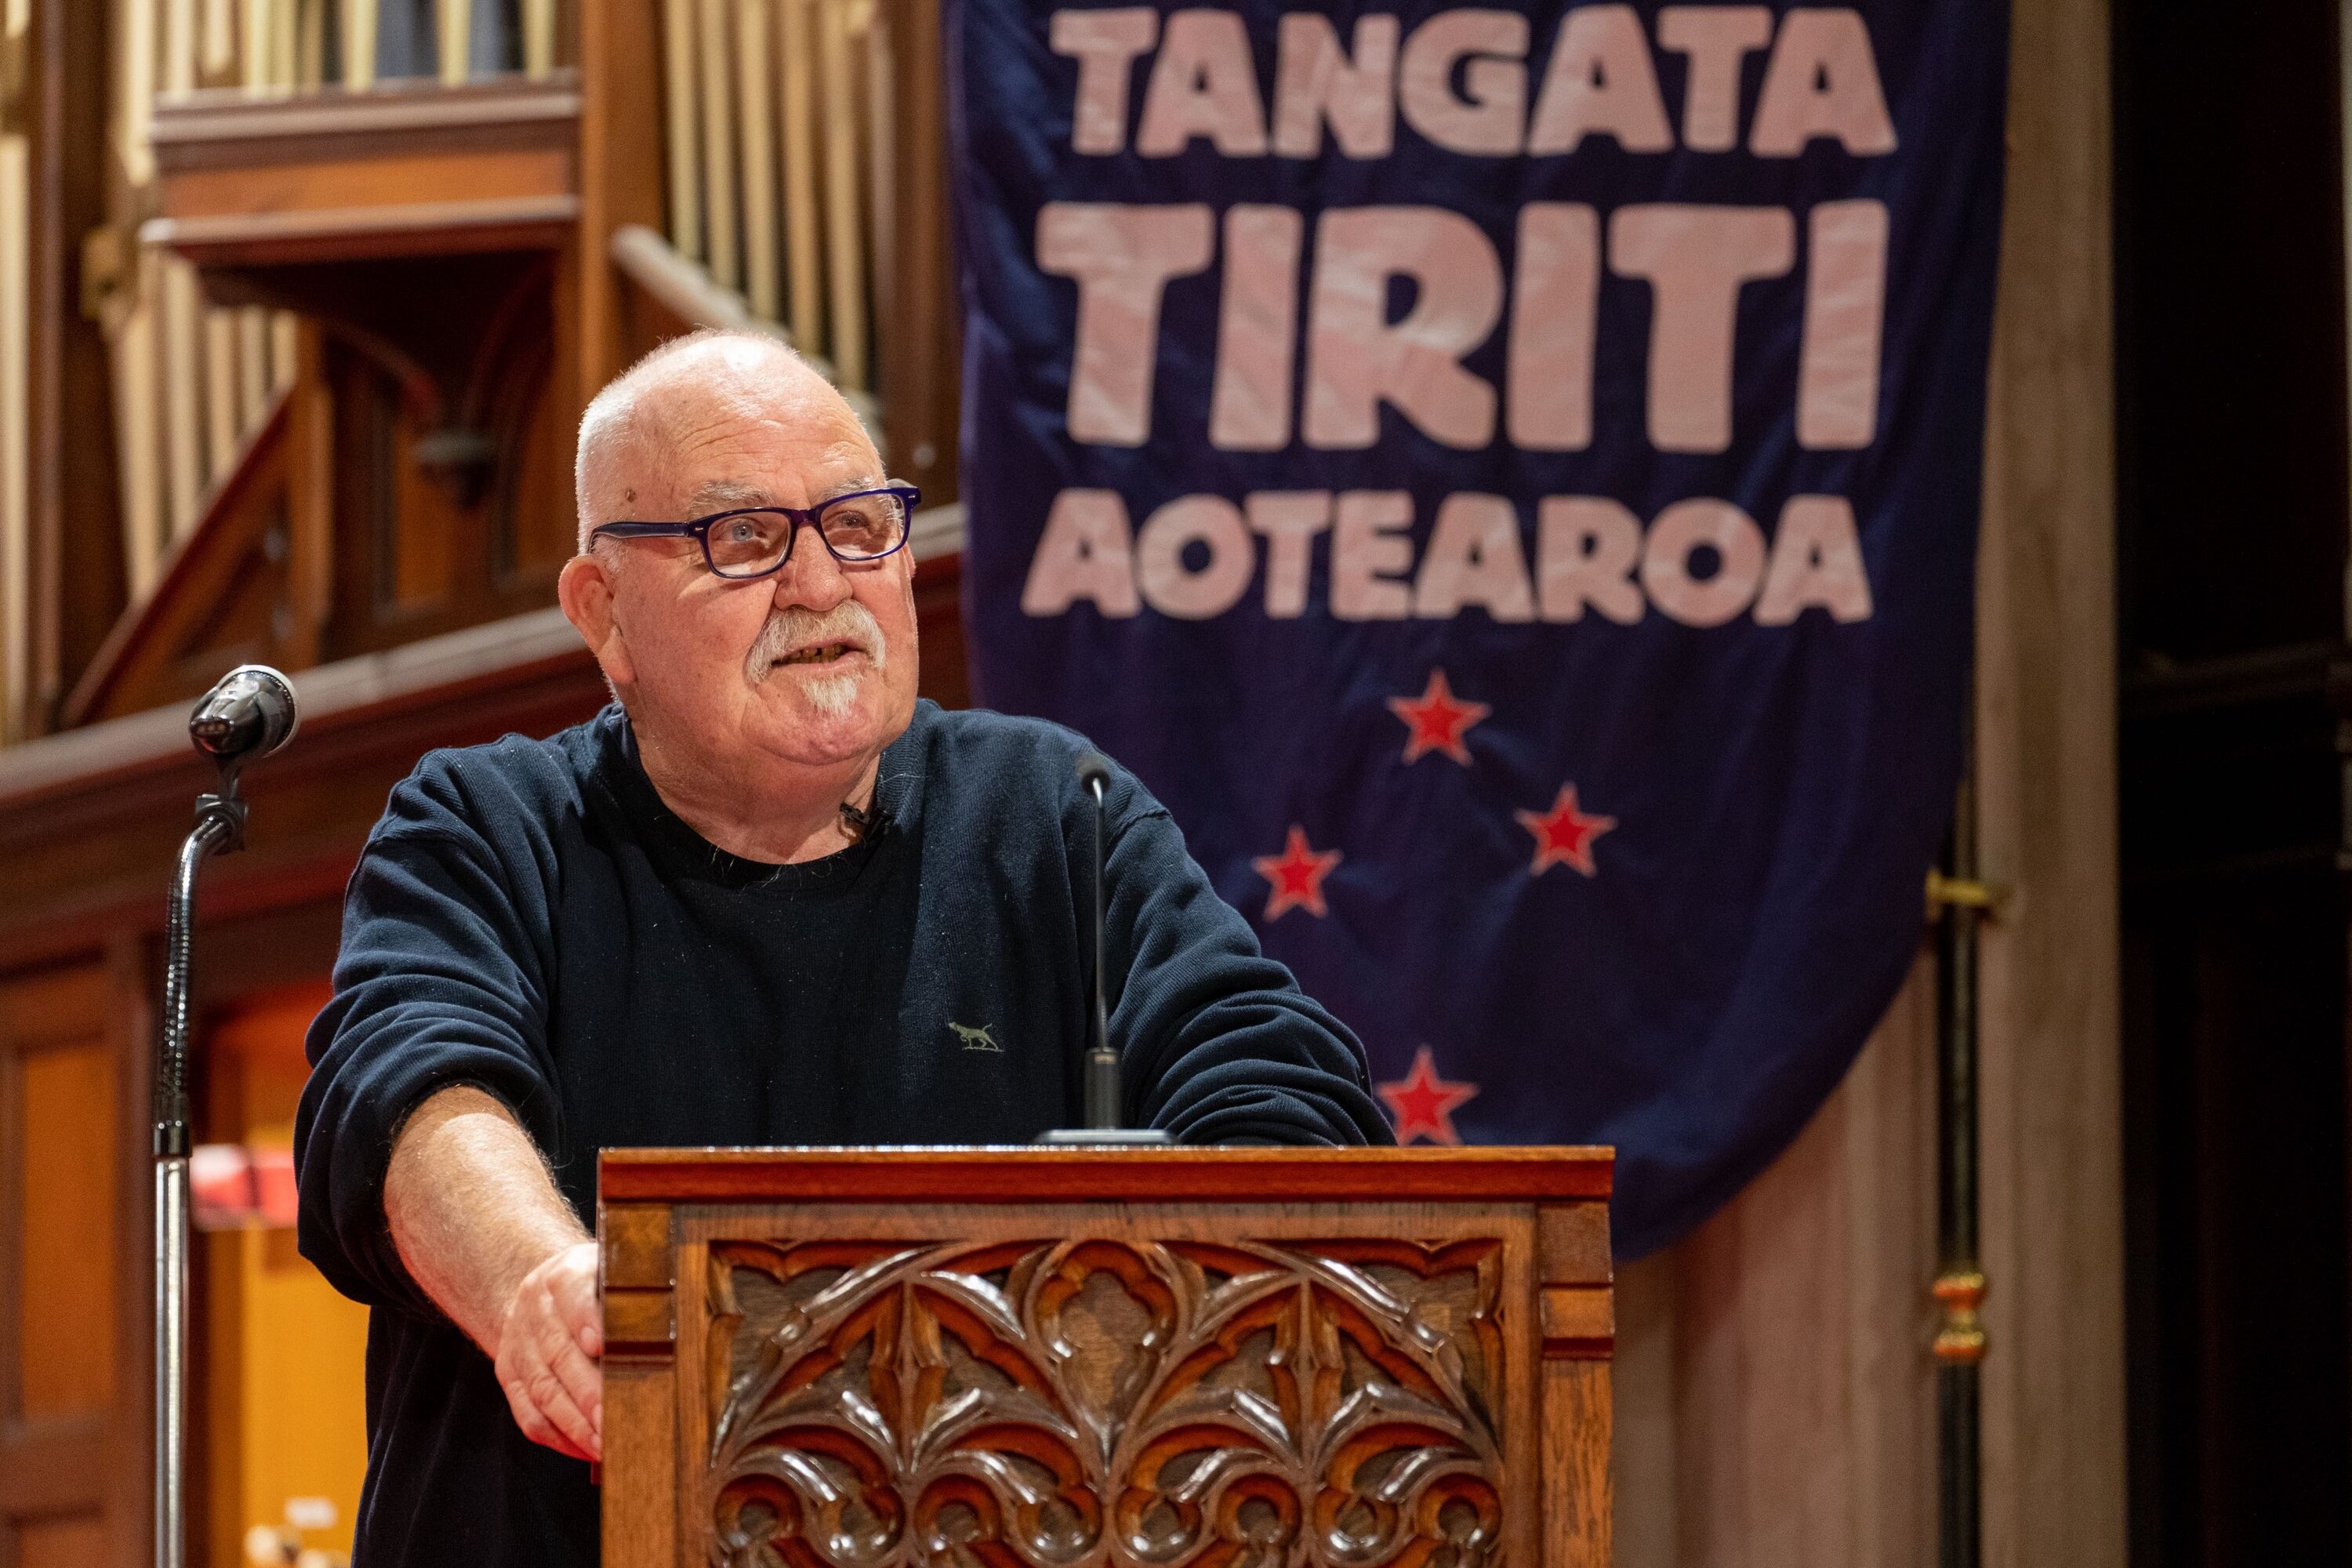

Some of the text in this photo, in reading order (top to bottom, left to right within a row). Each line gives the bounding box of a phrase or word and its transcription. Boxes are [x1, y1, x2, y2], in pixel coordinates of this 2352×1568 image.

[1052, 5, 1895, 157] TANGATA
[1037, 201, 1887, 450] TIRITI
[1022, 489, 1871, 625] AOTEAROA
